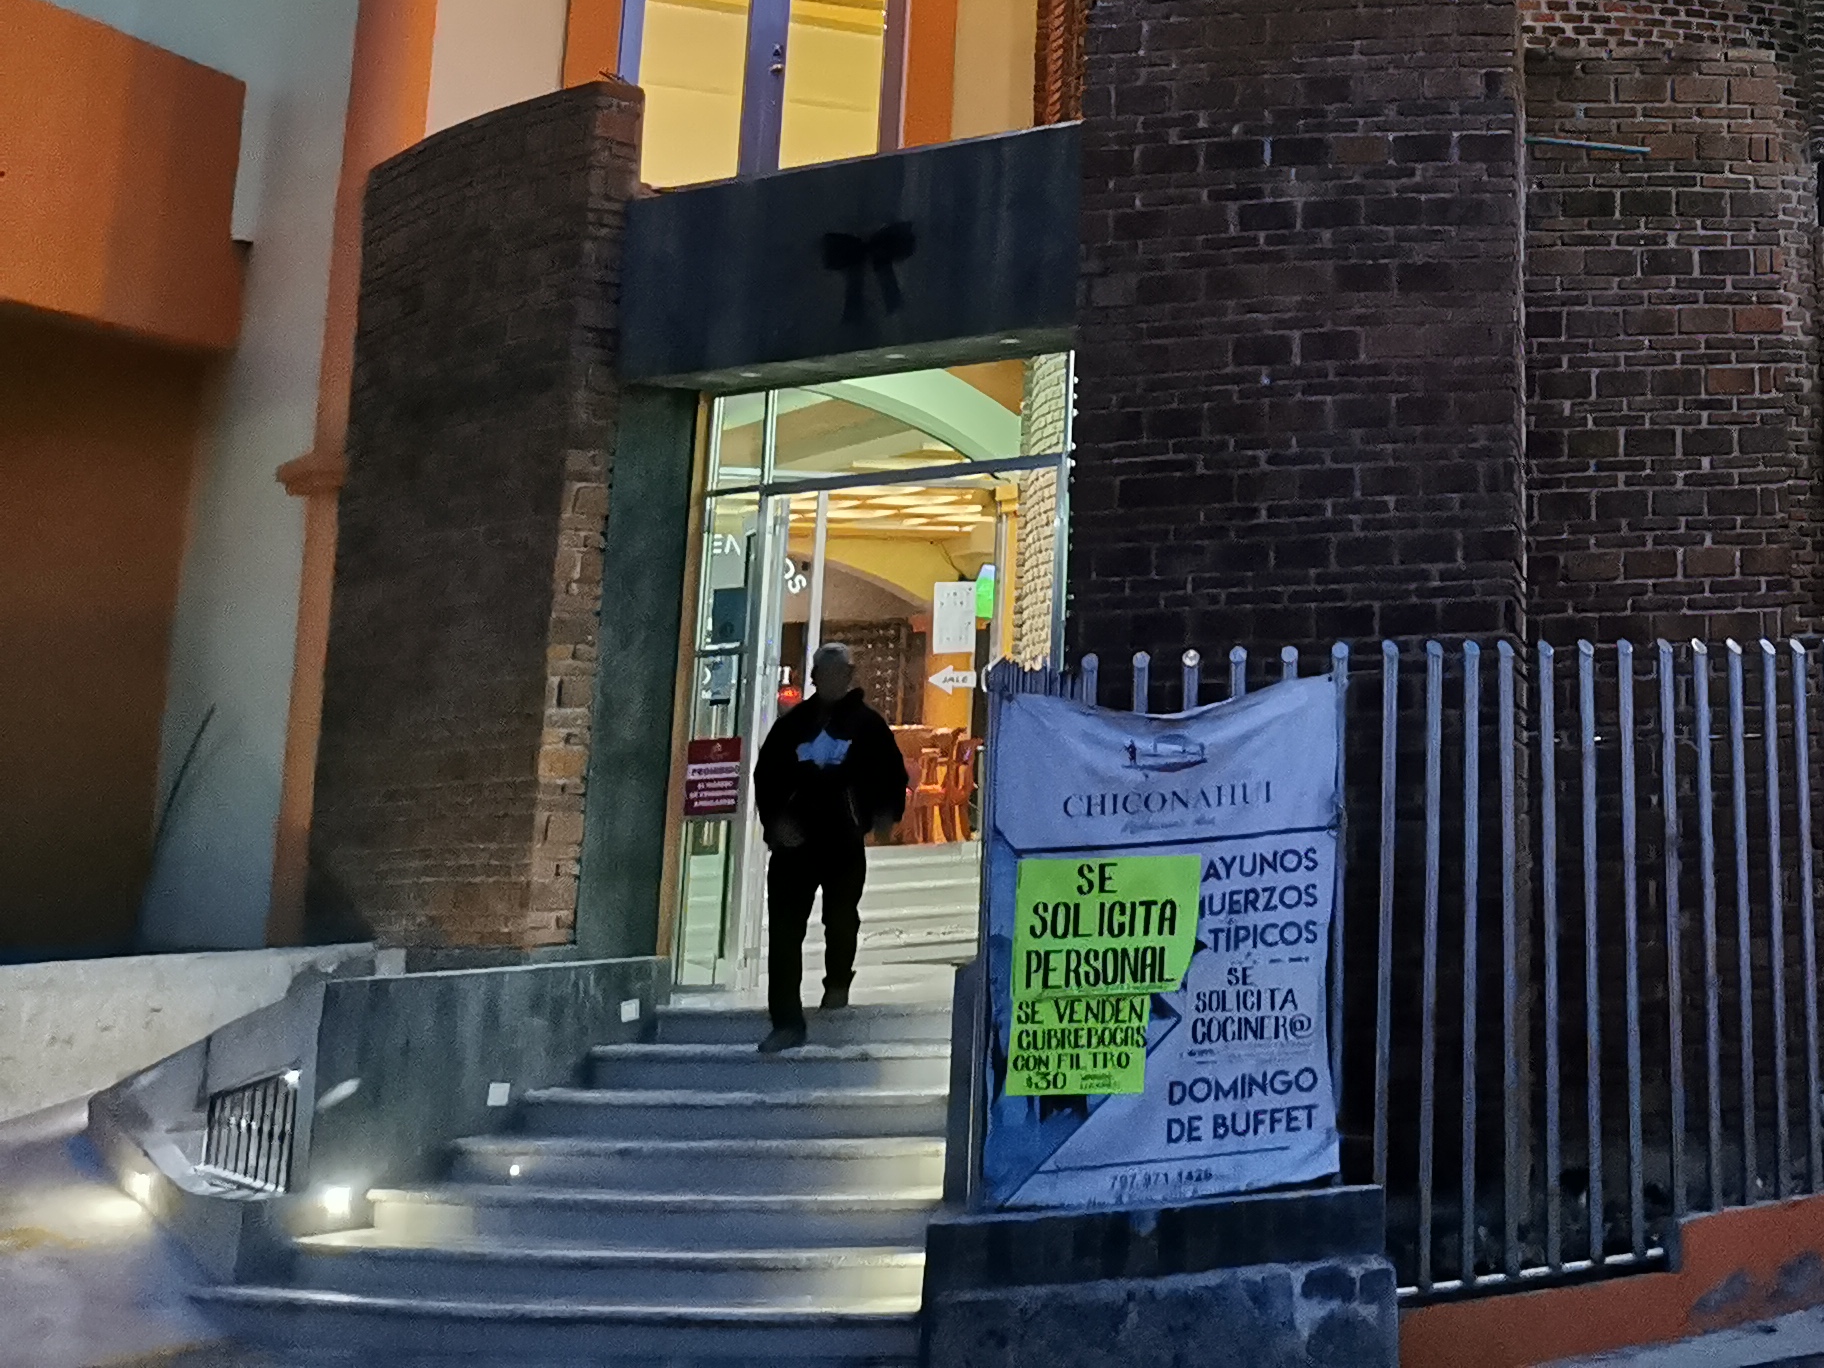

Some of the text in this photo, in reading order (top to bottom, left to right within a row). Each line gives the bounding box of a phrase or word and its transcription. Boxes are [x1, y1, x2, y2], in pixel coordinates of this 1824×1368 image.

[1063, 781, 1271, 818] CHICONAHUI
[1077, 863, 1118, 896] SE
[1029, 899, 1177, 938] SOLICITA
[1025, 946, 1176, 989] PERSONAL
[1227, 966, 1254, 986] SE
[1017, 998, 1145, 1024] SE VENDEN
[1194, 988, 1298, 1013] SOLICITA
[1017, 1026, 1147, 1051] CUBREBOCAS
[1013, 1054, 1049, 1072] CON
[1168, 1067, 1318, 1106] DOMINGO
[1166, 1104, 1319, 1144] DE BUFFET
